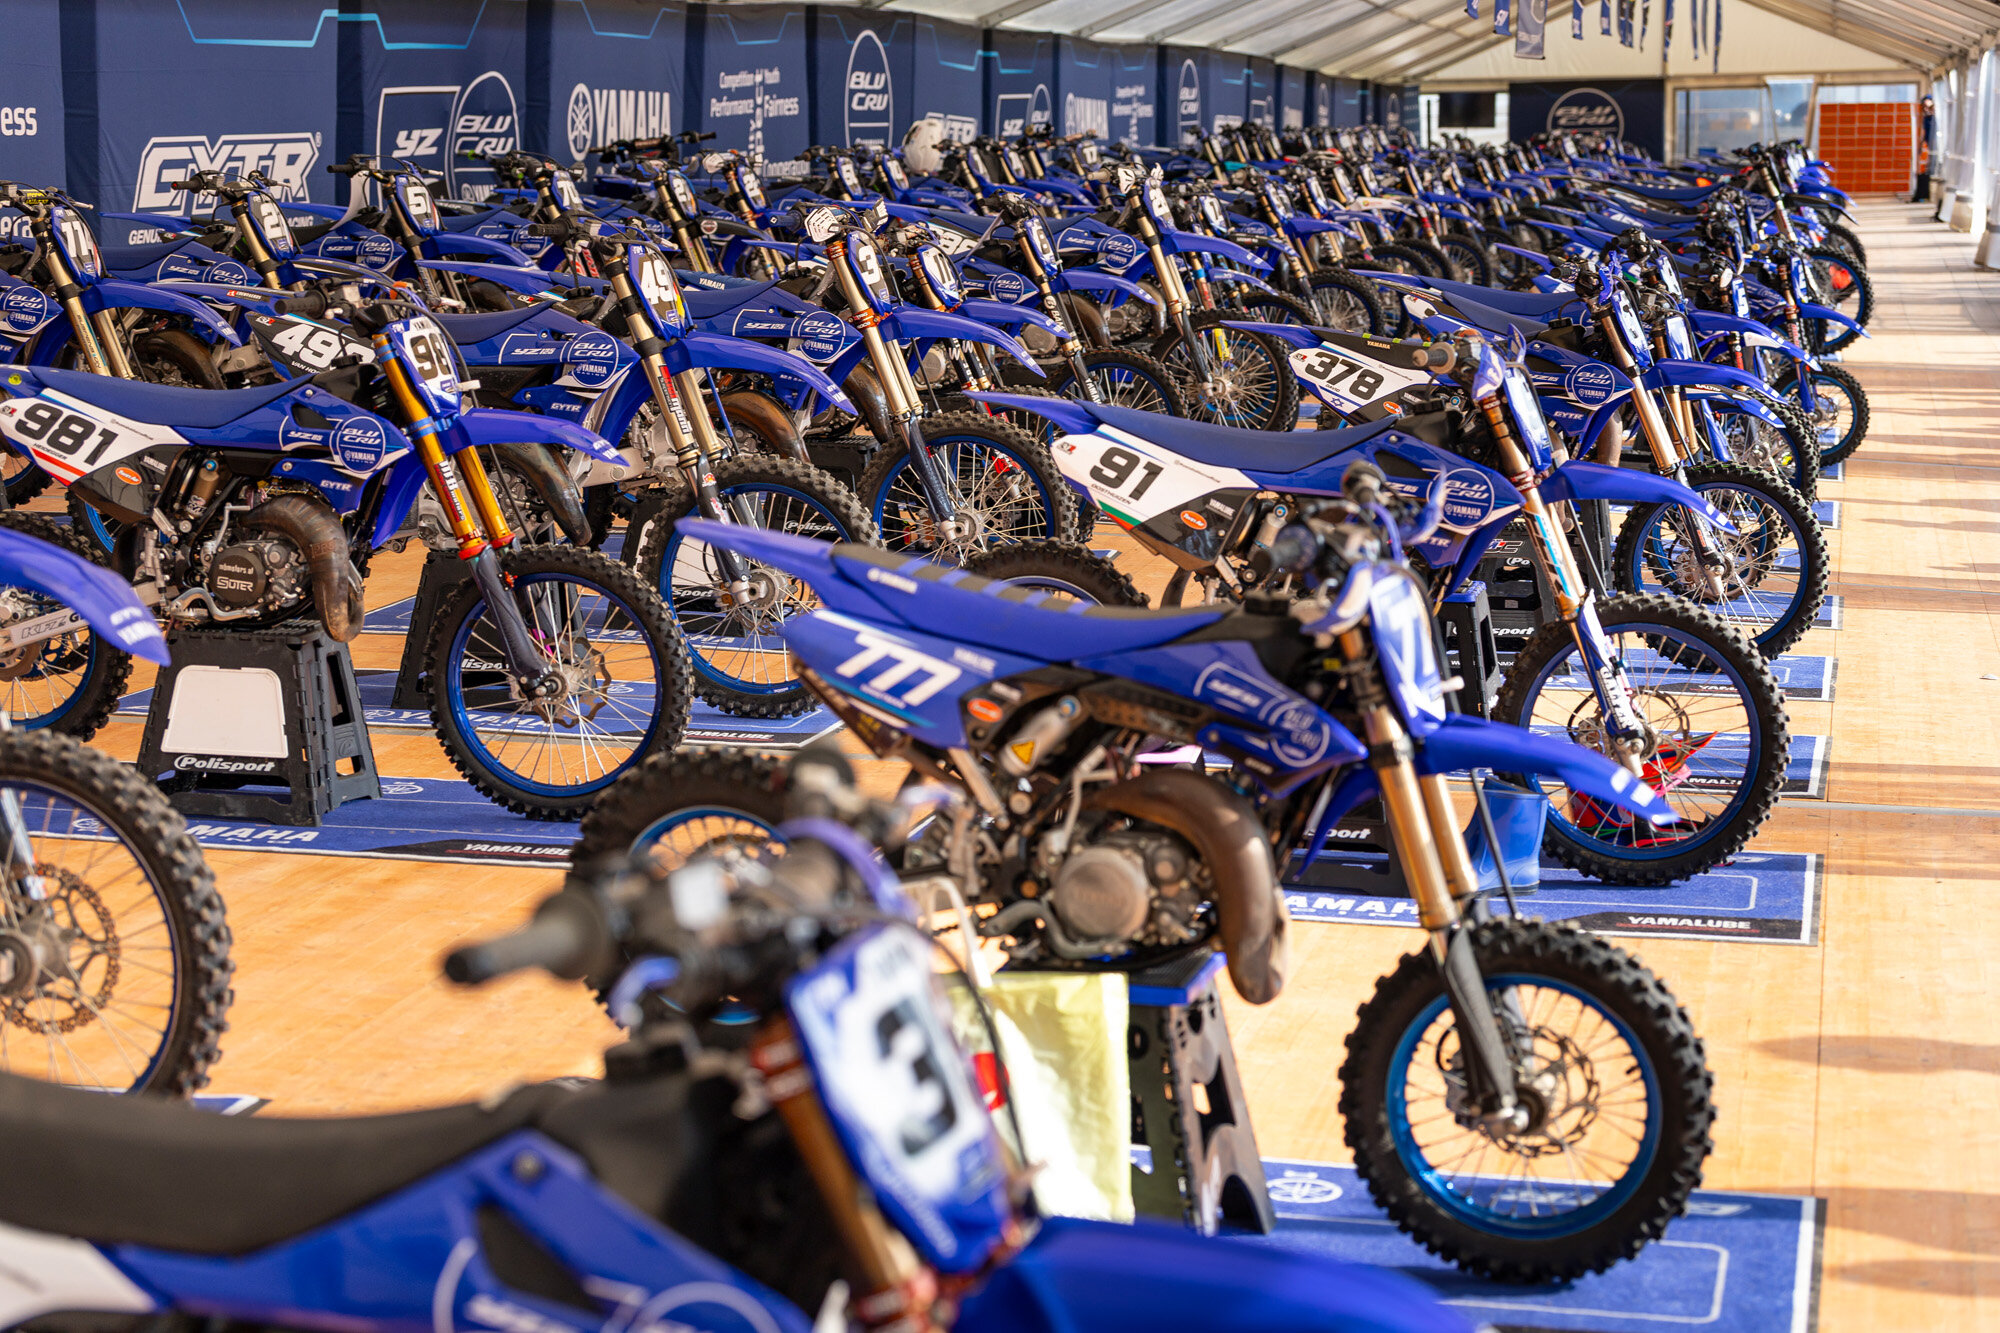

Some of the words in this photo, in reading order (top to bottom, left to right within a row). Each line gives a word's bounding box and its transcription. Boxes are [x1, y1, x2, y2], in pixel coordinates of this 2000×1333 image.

[850, 71, 886, 90] BLU
[710, 96, 754, 118] Performance
[764, 94, 799, 117] Fairness
[851, 92, 888, 111] CRU
[594, 89, 672, 145] YAMAHA
[456, 115, 512, 133] BLU
[392, 128, 443, 157] YZ
[455, 136, 514, 155] CRU
[699, 277, 726, 290] YAMAHA
[8, 294, 42, 302] BLU
[9, 301, 43, 309] CRU
[803, 320, 840, 328] BLU
[804, 327, 841, 335] CRU
[573, 342, 613, 350] BLU
[810, 340, 834, 351] YAMAHA
[1366, 340, 1391, 350] YAMAHA
[582, 364, 607, 374] YAMAHA
[1576, 371, 1610, 379] BLU
[1304, 351, 1385, 400] 378
[1577, 377, 1612, 385] CRU
[1584, 389, 1606, 398] YAMAHA
[550, 402, 582, 413] GYTR
[1553, 410, 1584, 420] GYTR
[15, 403, 119, 466] 981
[341, 428, 381, 437] BLU
[342, 435, 382, 445] CRU
[351, 451, 376, 461] YAMAHA
[1089, 446, 1164, 502] 91
[320, 480, 353, 492] GYTR
[1446, 480, 1488, 491] BLU
[1447, 489, 1490, 499] CRU
[1453, 507, 1482, 517] YAMAHA
[786, 520, 837, 532] Polispo
[217, 576, 254, 592] SUTER
[673, 588, 714, 599] sport
[1492, 626, 1535, 637] sport
[461, 658, 510, 671] lispo
[836, 631, 963, 706] 777
[683, 729, 775, 741] YAMALUBE
[175, 755, 275, 774] Polisport
[184, 824, 320, 842] MAHA
[462, 842, 571, 855] YAMALUBE
[1284, 895, 1420, 915] AMAH
[1628, 915, 1751, 930] YAMALUBE
